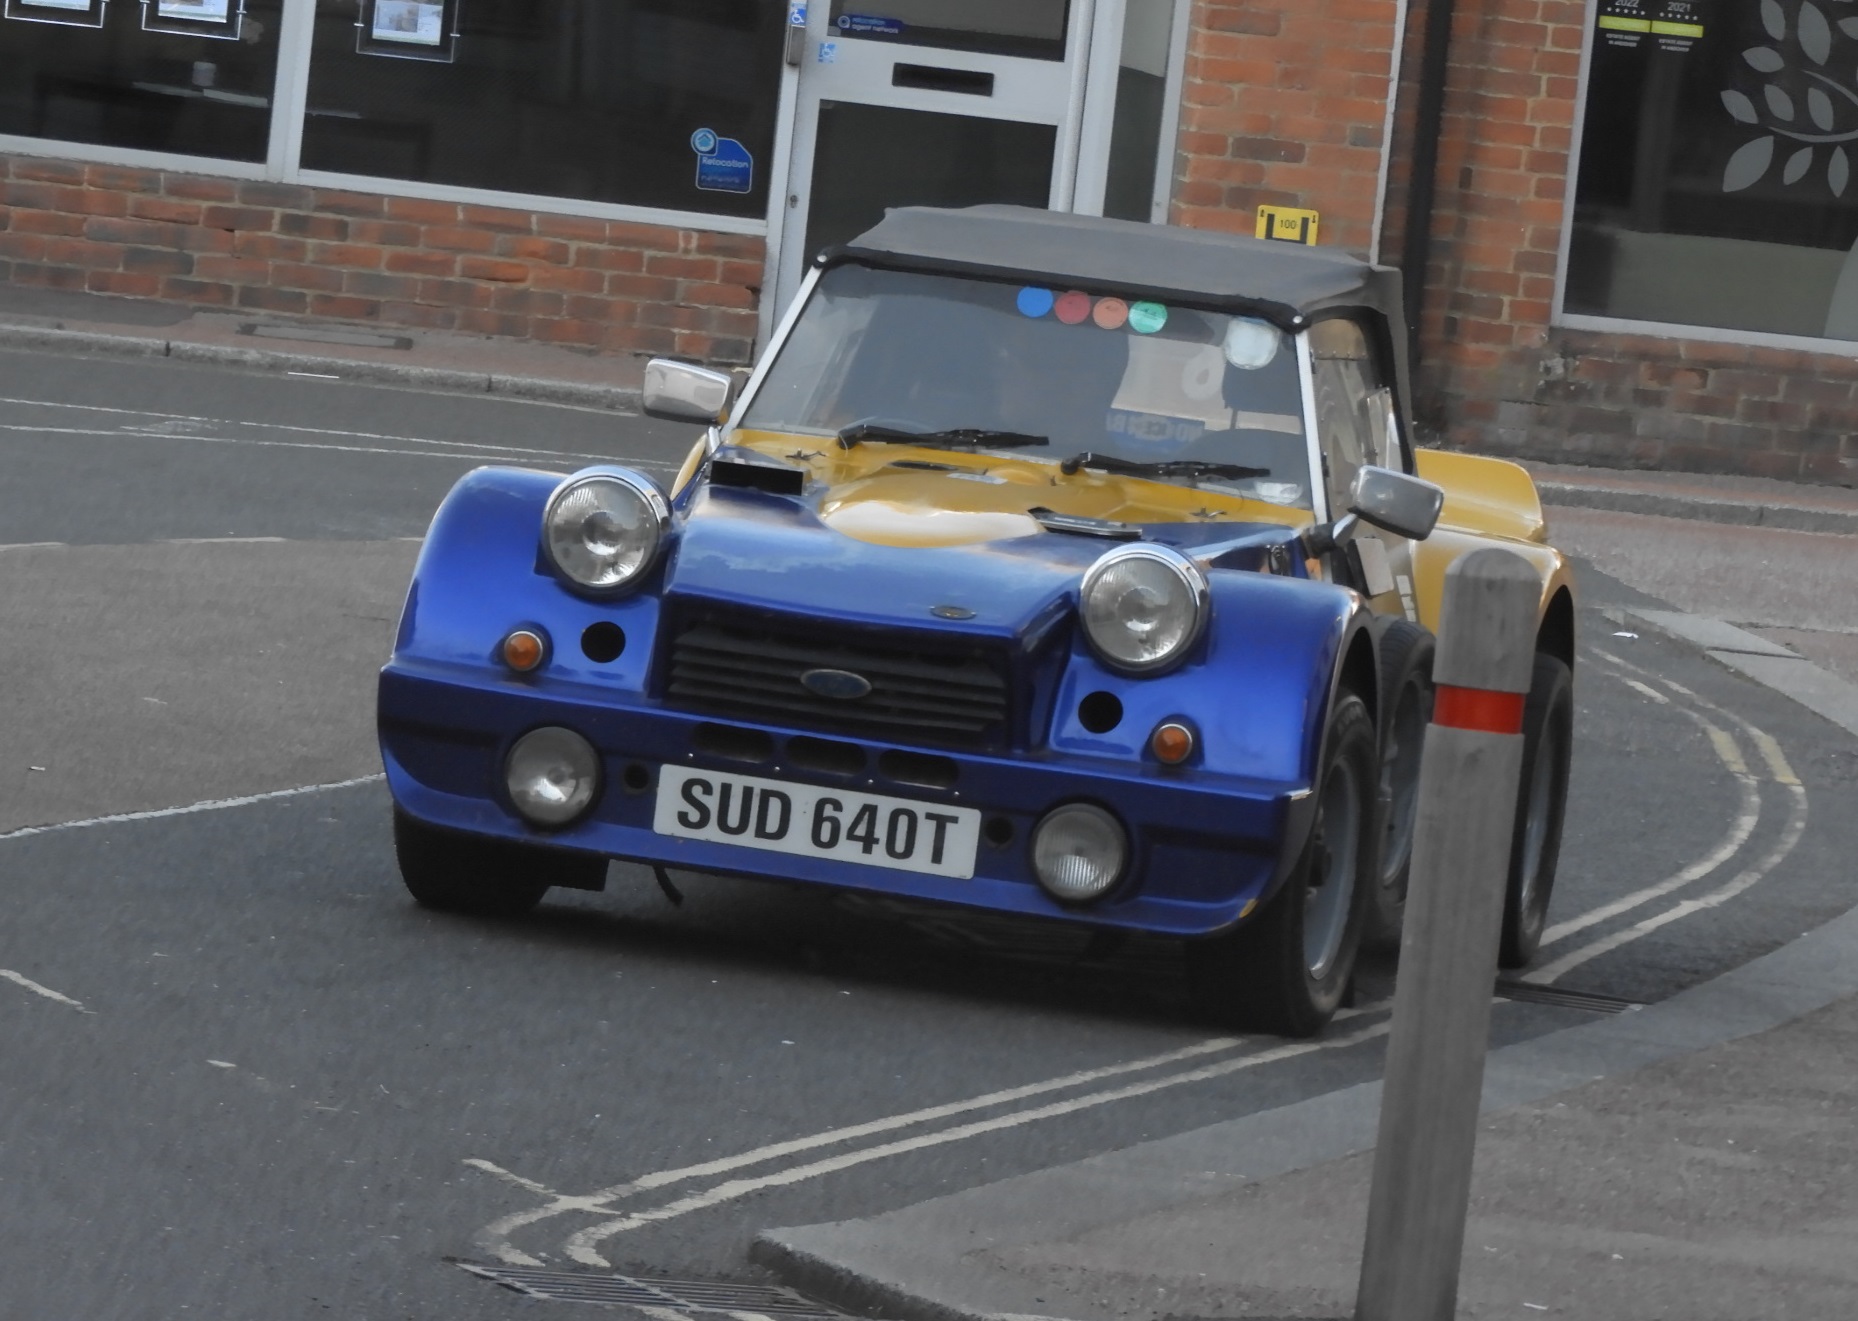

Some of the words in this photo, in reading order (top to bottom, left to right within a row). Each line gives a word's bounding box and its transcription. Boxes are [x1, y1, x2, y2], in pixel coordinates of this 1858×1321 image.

[1667, 2, 1691, 12] 2021
[1280, 219, 1297, 229] 100
[677, 778, 792, 841] SUD
[811, 797, 959, 865] 640T
